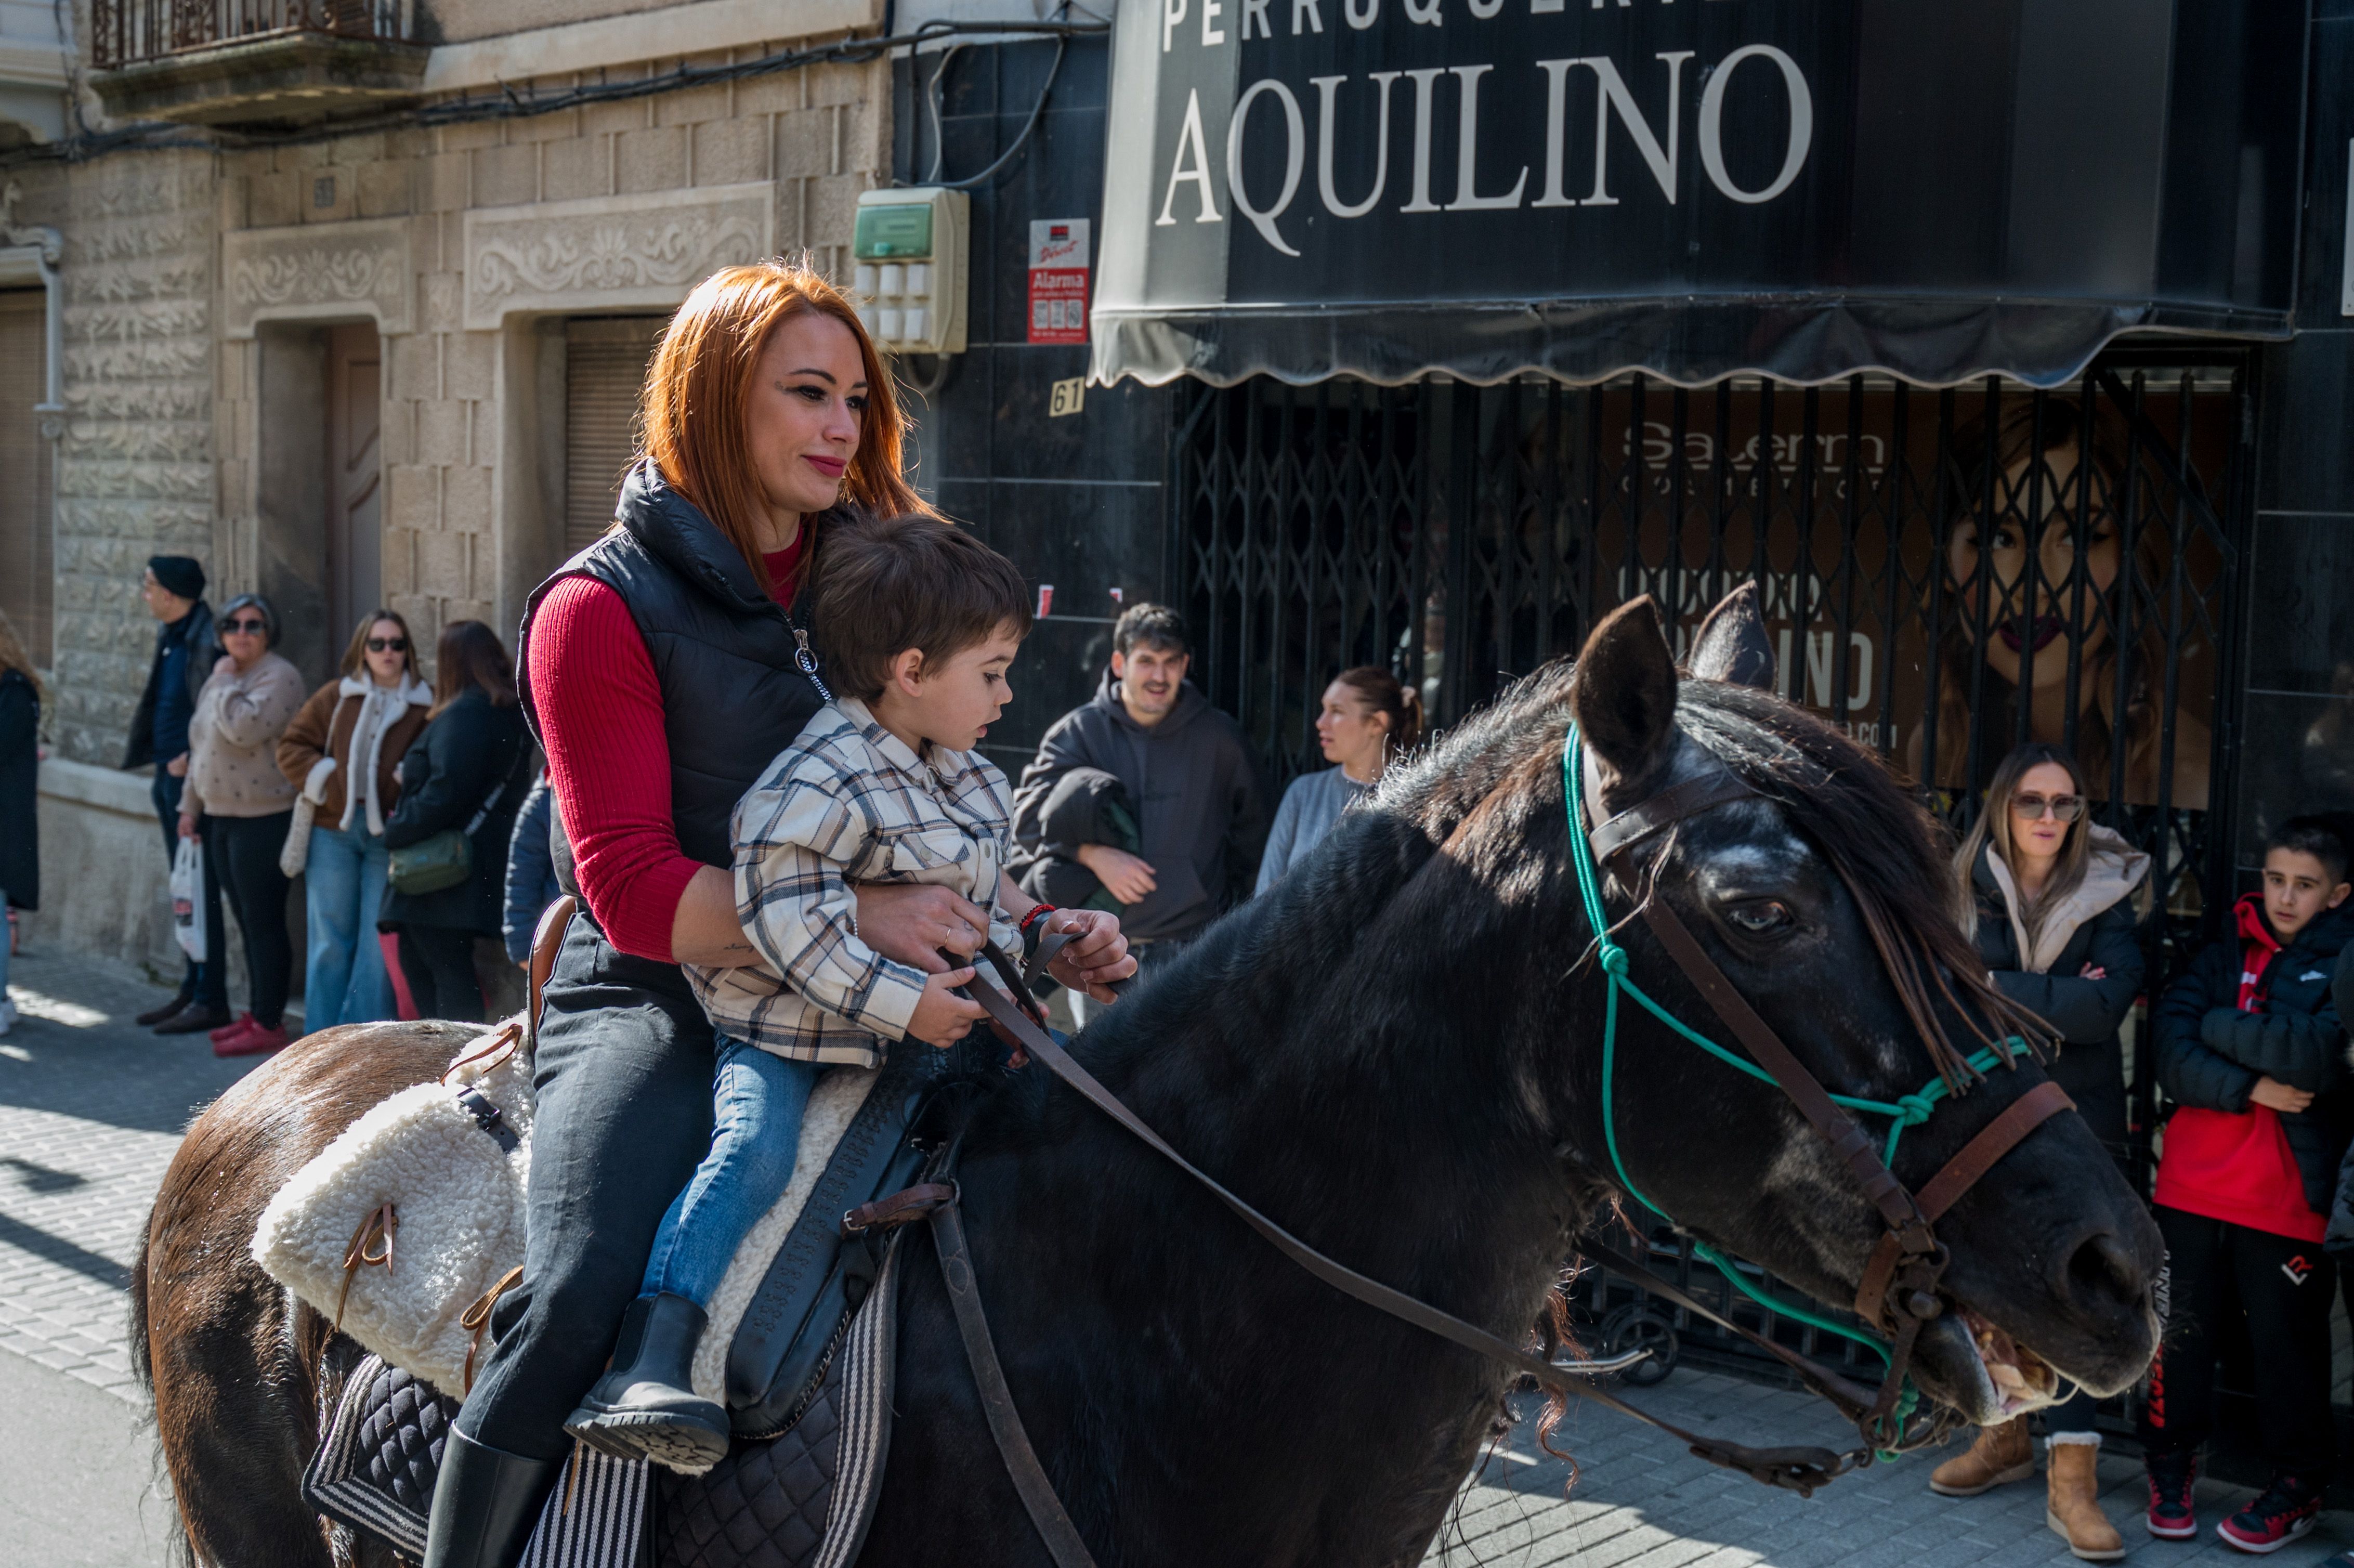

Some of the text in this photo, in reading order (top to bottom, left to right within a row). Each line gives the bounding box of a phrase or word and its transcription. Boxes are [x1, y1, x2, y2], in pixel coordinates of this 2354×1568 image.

[1155, 44, 1812, 256] AQUILINO
[1033, 272, 1084, 289] Alarma
[1054, 381, 1079, 412] 61
